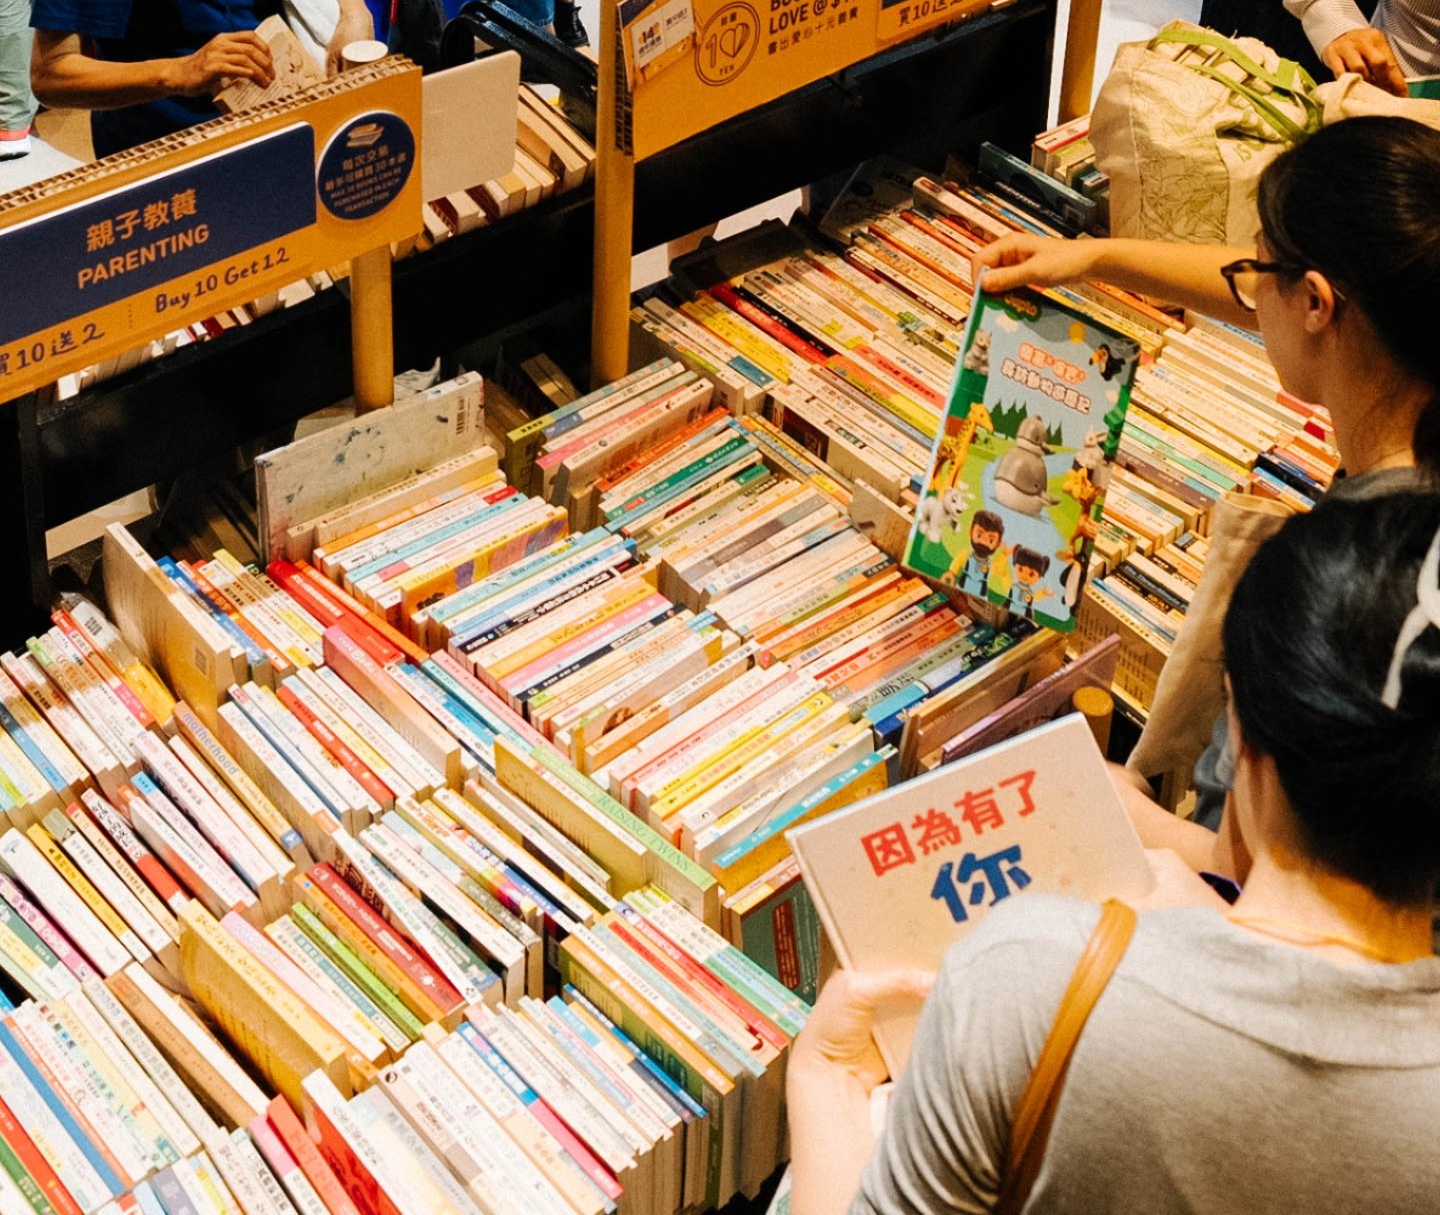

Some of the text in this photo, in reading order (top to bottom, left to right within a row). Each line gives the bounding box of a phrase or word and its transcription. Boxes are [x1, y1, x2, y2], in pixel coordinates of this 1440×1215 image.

[768, 2, 808, 35] LOVE
[86, 188, 197, 253] 親子教養
[77, 223, 210, 289] PARENTING
[155, 292, 191, 315] Buy
[193, 273, 219, 297] 10
[224, 259, 259, 287] Get
[180, 711, 240, 777] motherhood
[595, 792, 693, 873] RAISING TWINS
[860, 768, 1039, 878] 因為有了
[930, 844, 1034, 923] 你
